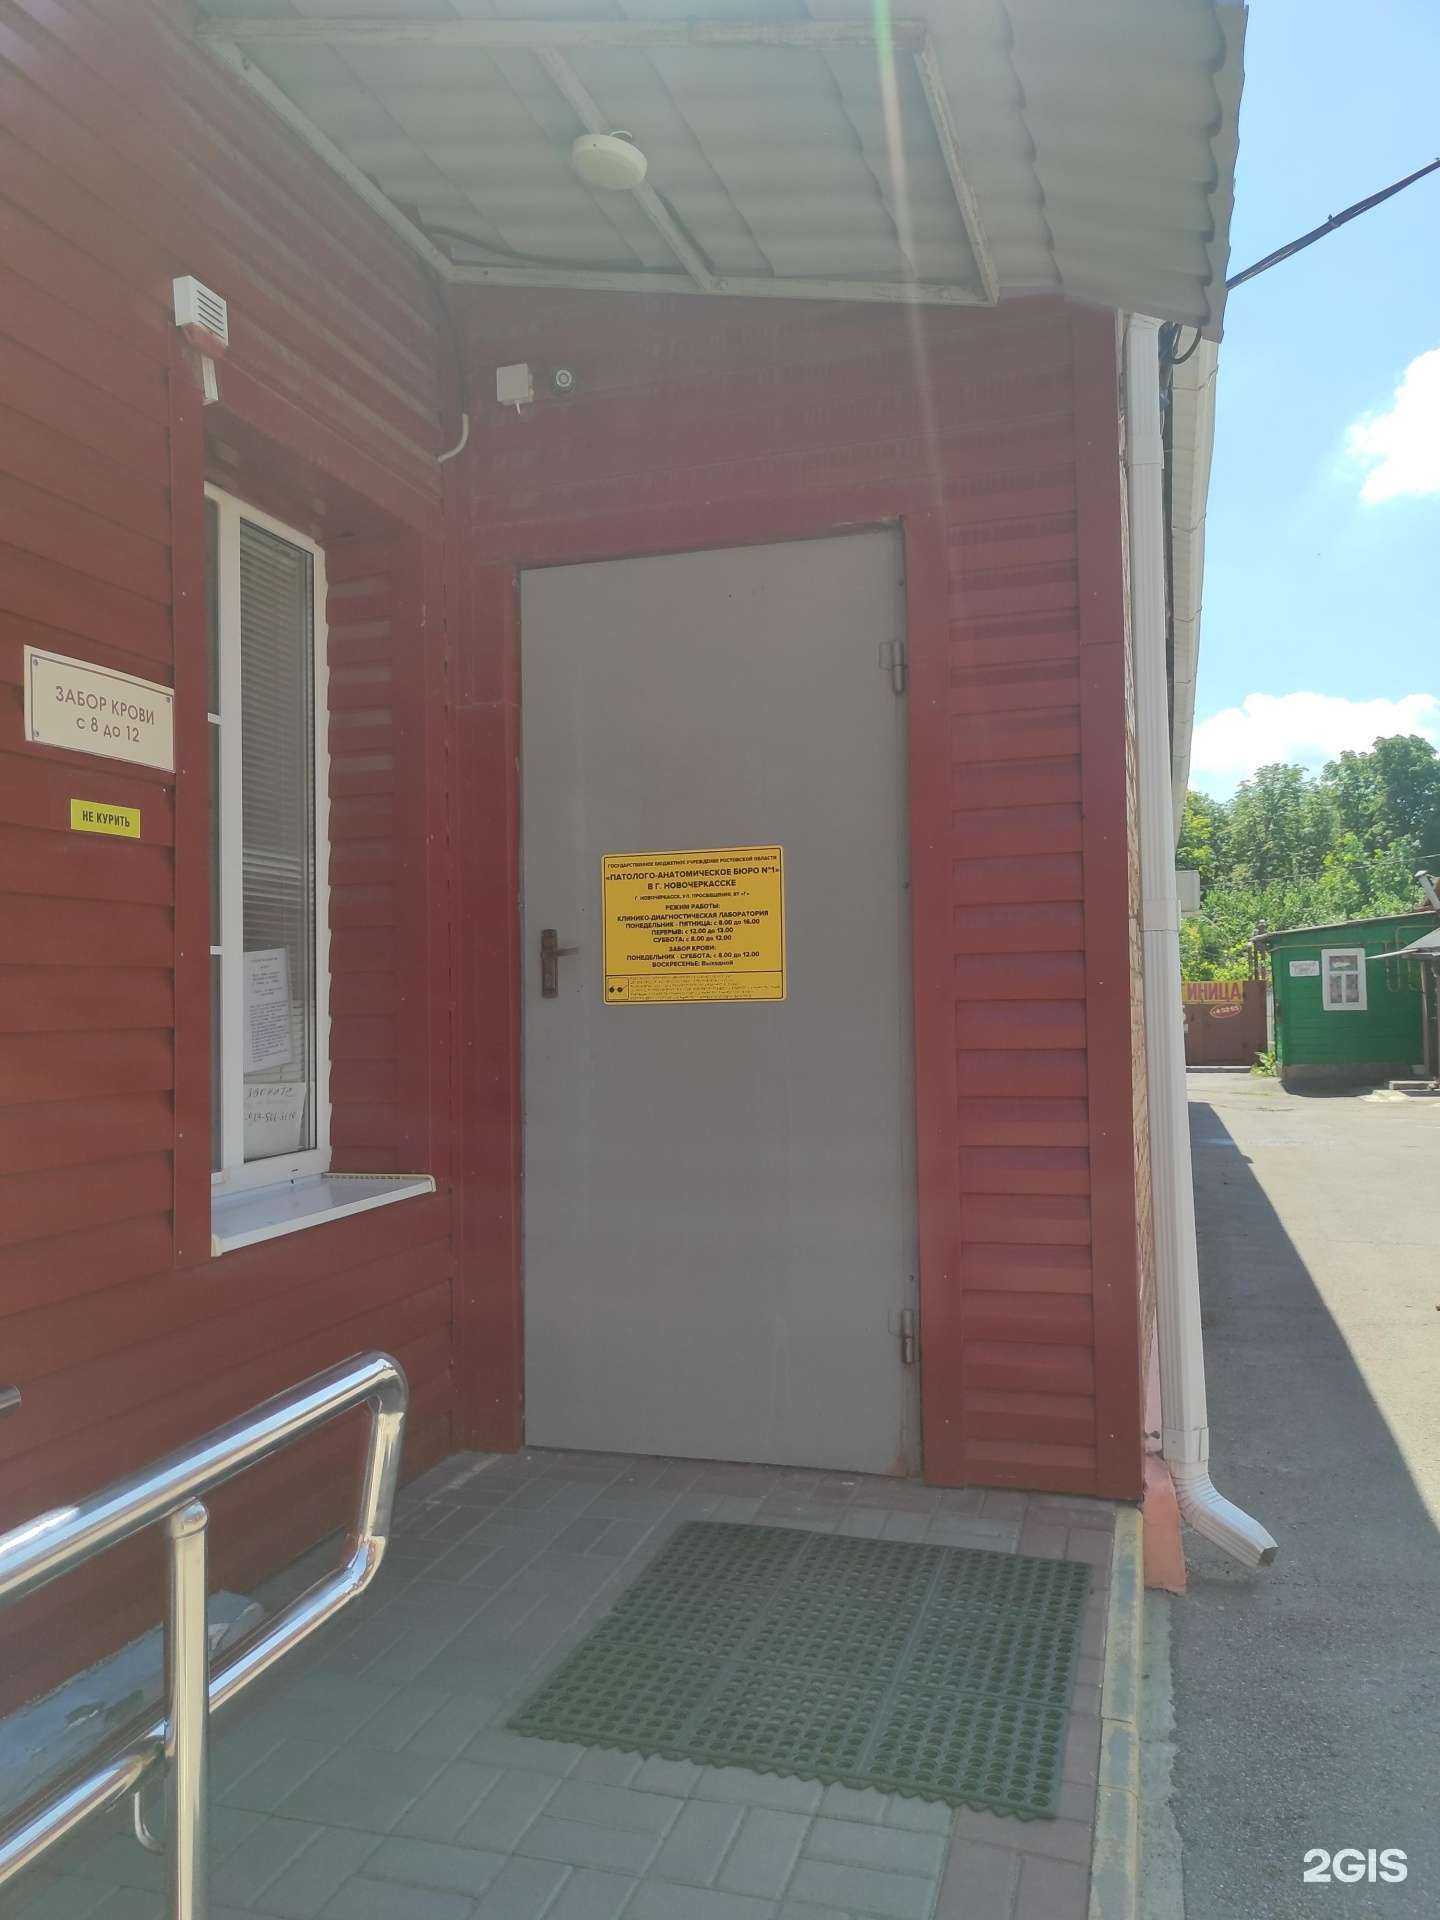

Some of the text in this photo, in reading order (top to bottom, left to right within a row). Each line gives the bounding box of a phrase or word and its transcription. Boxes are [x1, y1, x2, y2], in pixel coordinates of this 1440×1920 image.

[55, 685, 155, 725] ЗАБОР КРОВИ
[76, 717, 140, 742] с 8 до 12
[82, 810, 130, 828] НЕ КУРИТЬ
[733, 866, 760, 875] БЮРО
[647, 882, 653, 890] В
[663, 879, 737, 889] НОВОЧЕРКАССКЕ
[617, 910, 769, 922] КЛИНИКО-ДИАГНОСТИЧЕСКАЯ ЛАБОРАТОРИЯ
[626, 953, 675, 961] ПОНЕДЕЛЬНИК
[1187, 982, 1240, 1002] ИНИЦА
